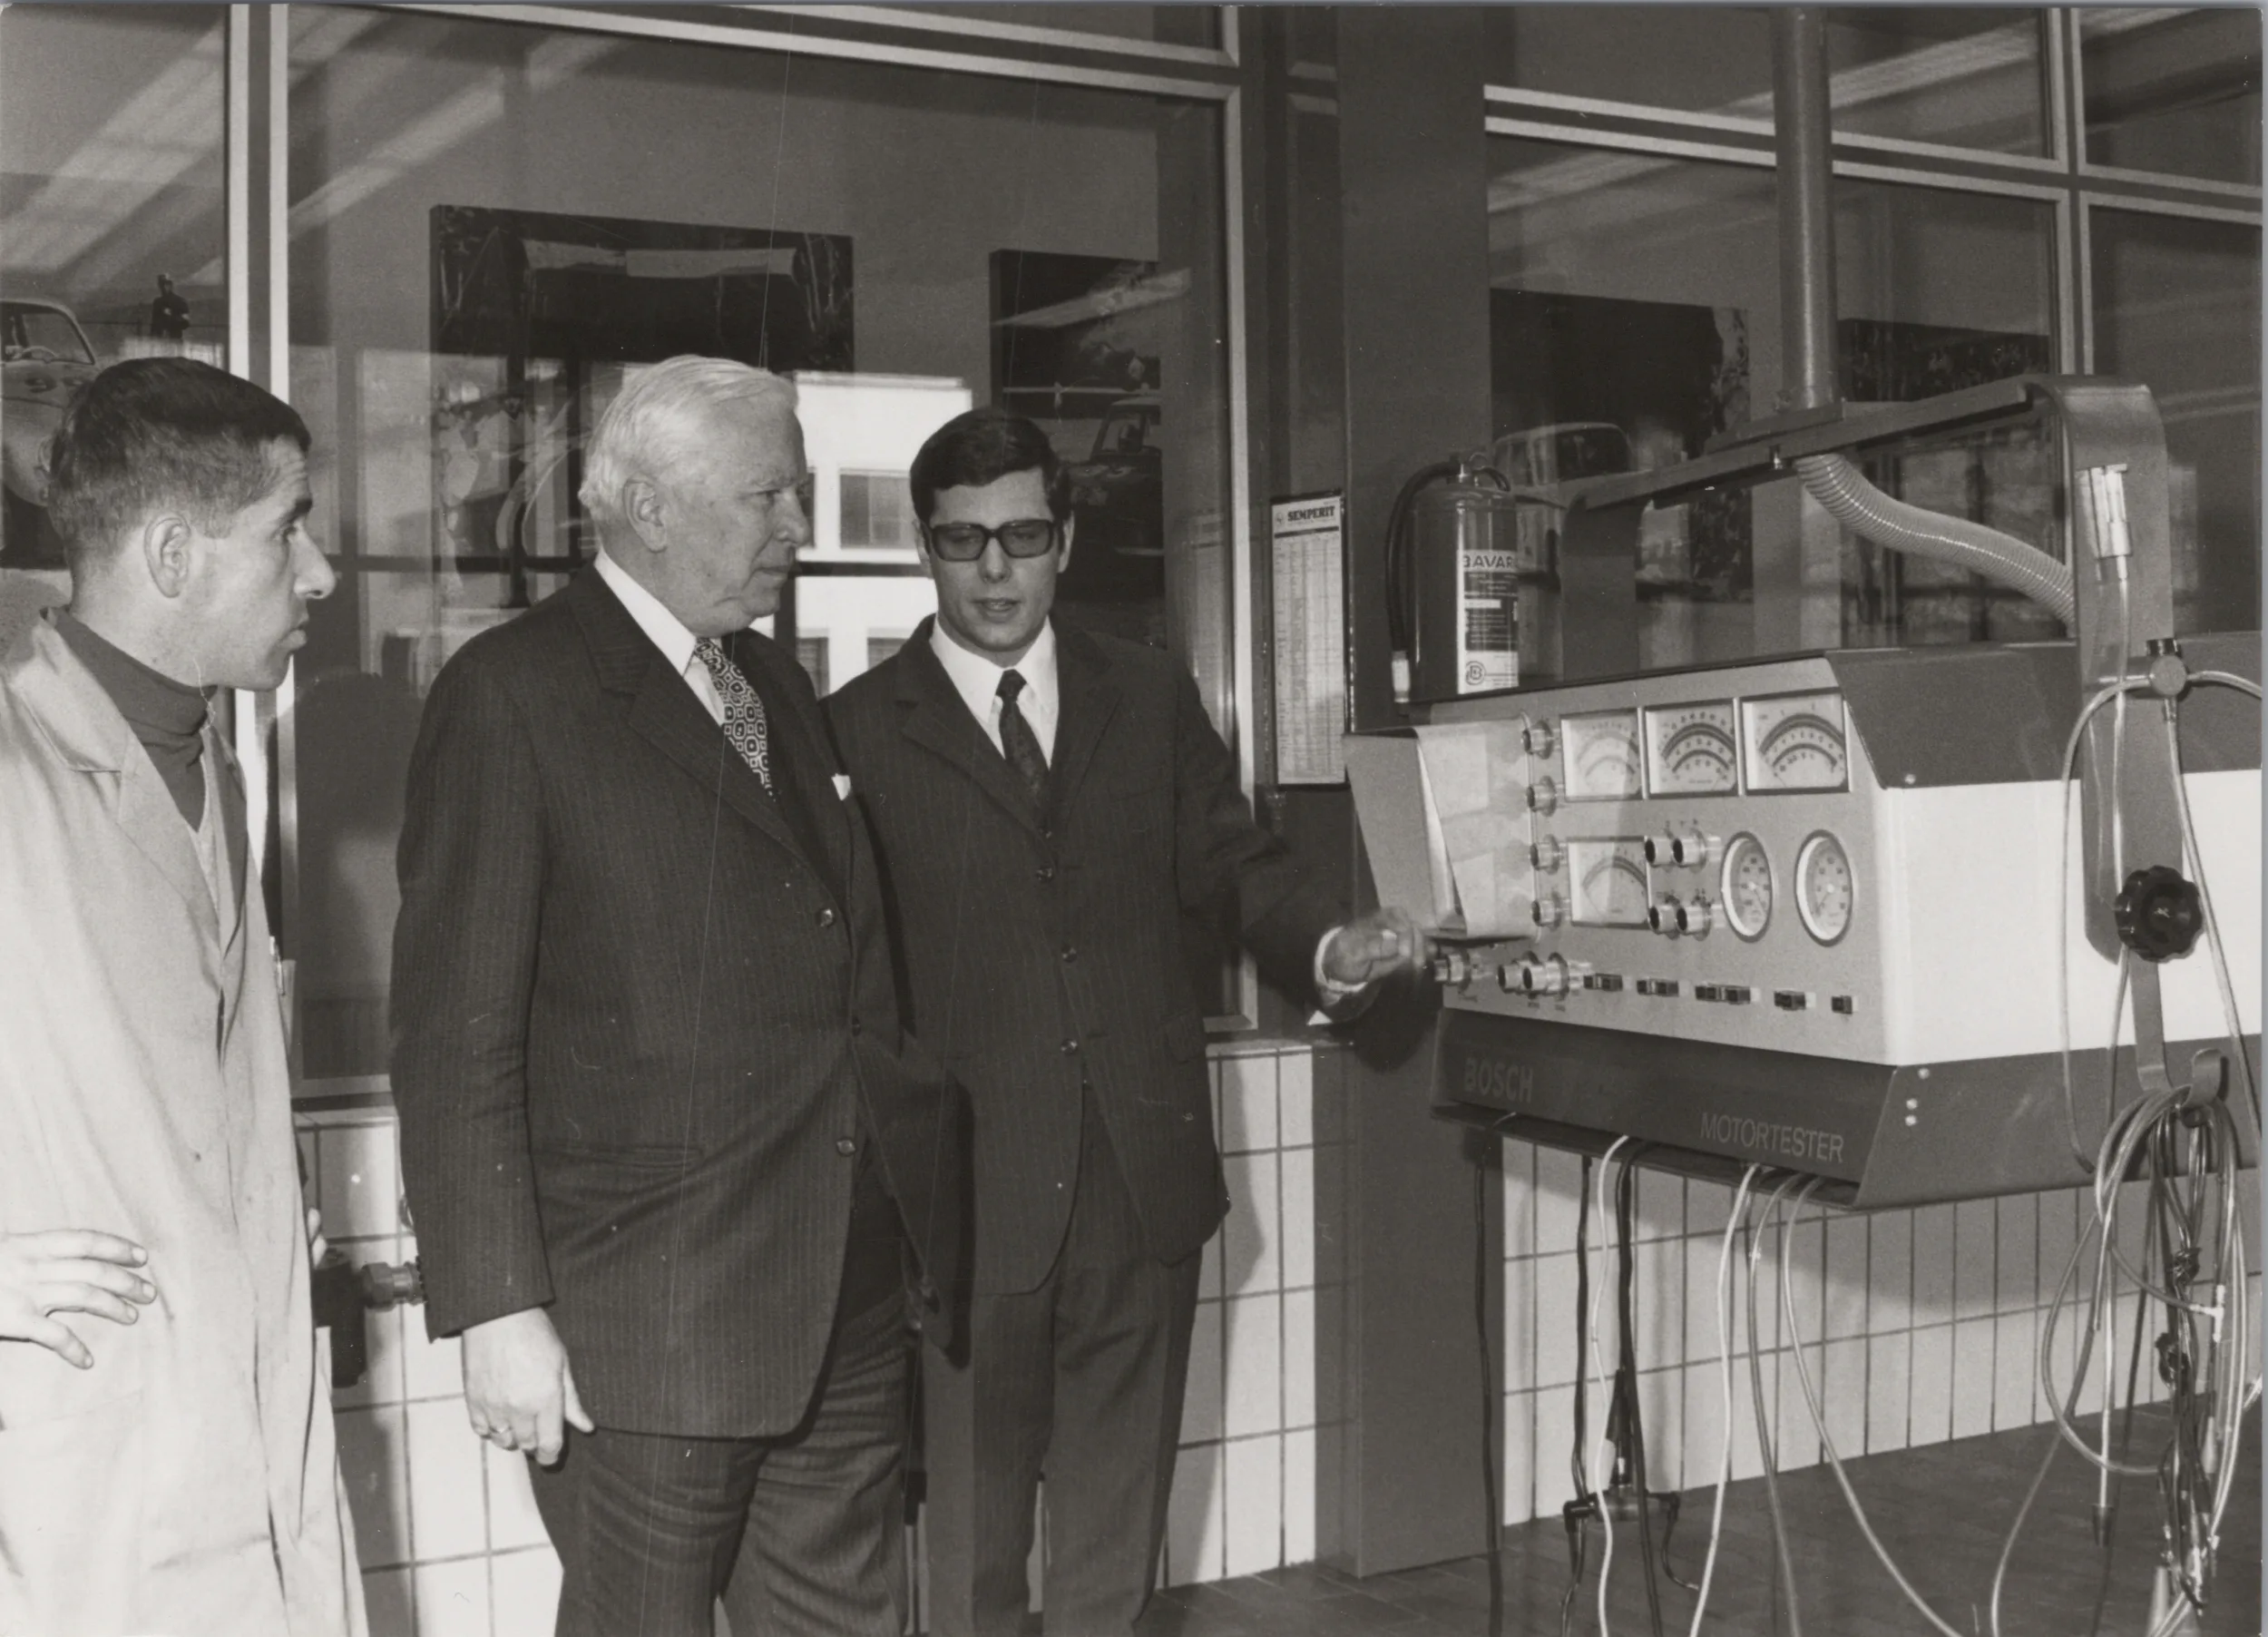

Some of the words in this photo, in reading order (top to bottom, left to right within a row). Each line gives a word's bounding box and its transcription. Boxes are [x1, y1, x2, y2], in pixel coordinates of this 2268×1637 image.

[1287, 505, 1335, 522] SEMPERIT
[1464, 1058, 1533, 1104] BOSCH
[1700, 1113, 1844, 1163] MOTORTESTER
